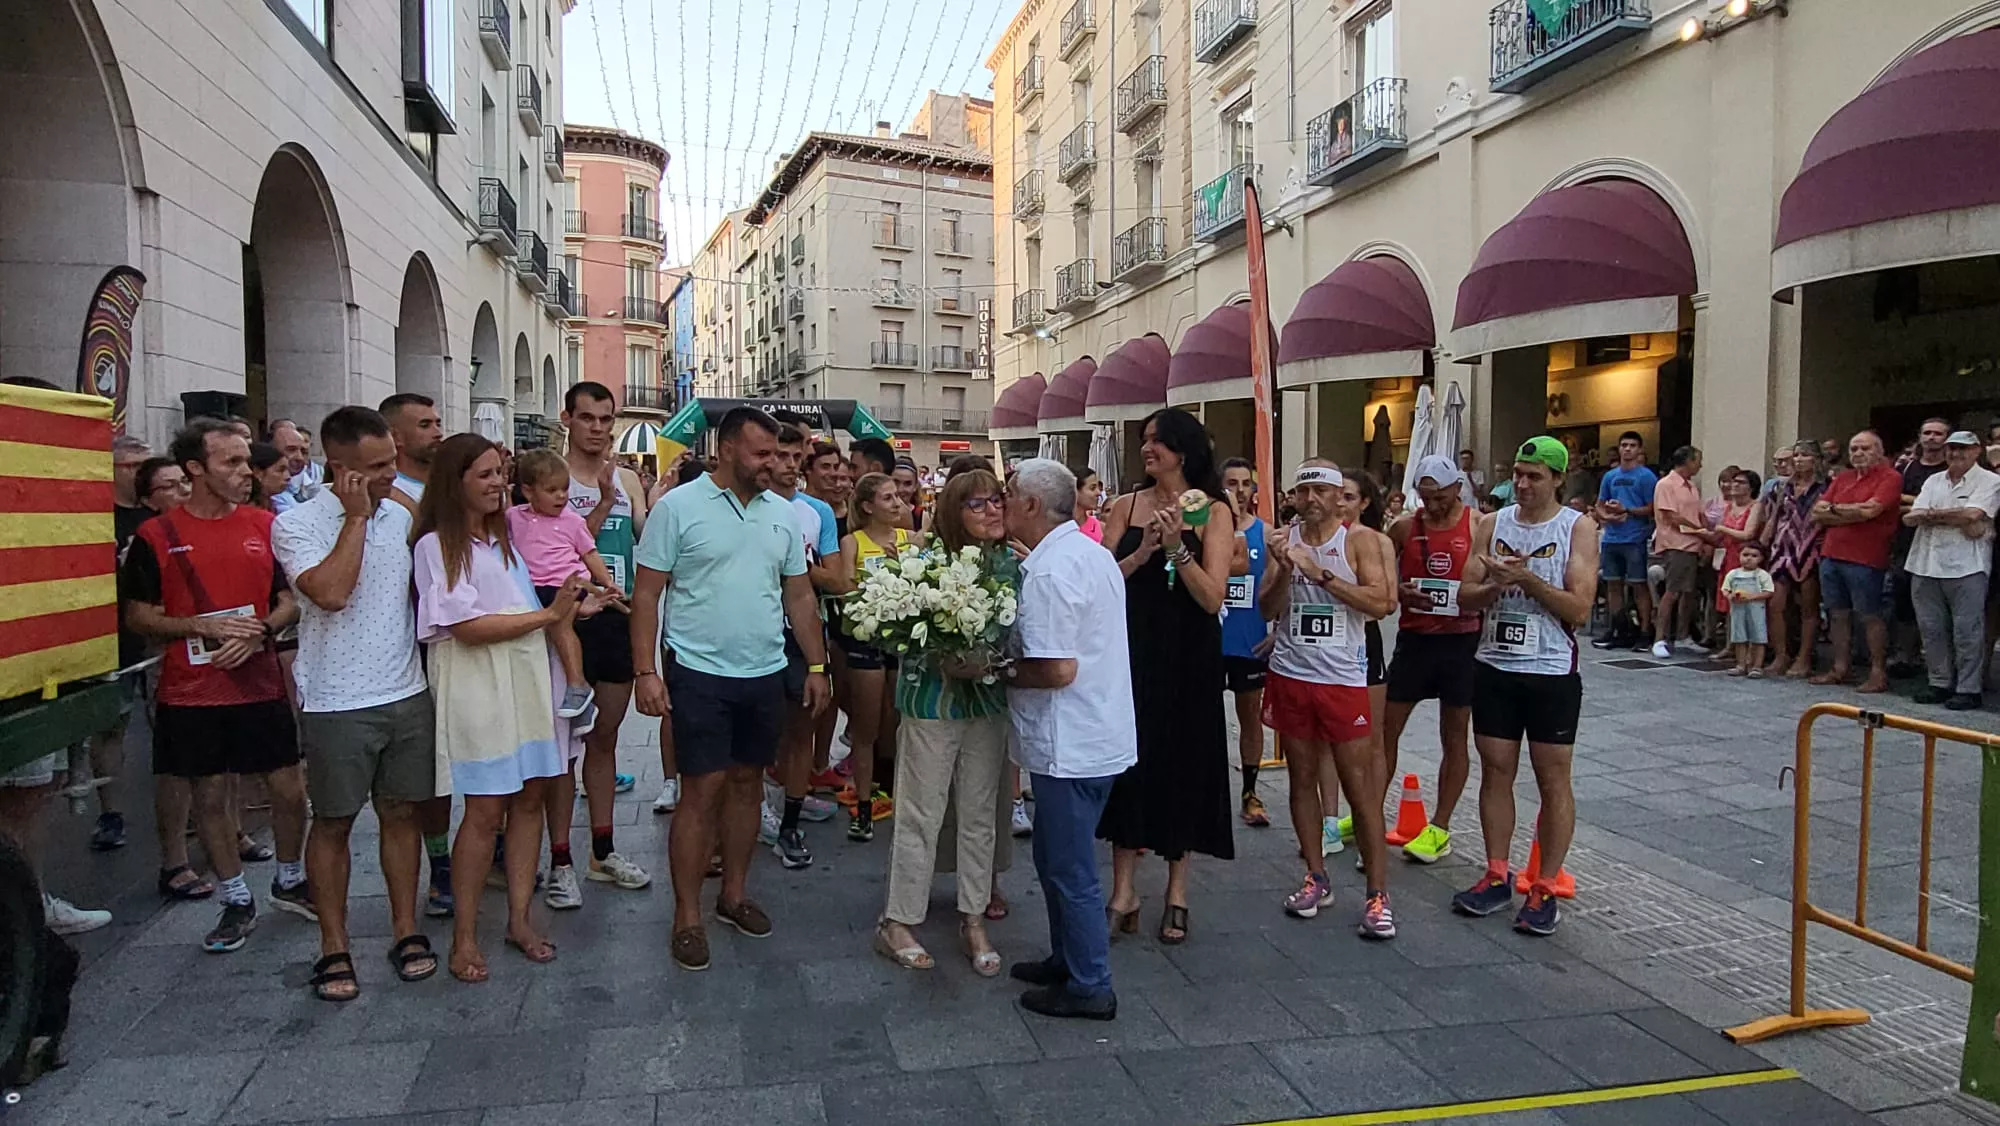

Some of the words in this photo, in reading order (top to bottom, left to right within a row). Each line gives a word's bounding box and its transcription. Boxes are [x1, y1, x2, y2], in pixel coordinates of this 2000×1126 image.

[979, 300, 989, 367] HOSTAL
[1229, 586, 1244, 598] 56
[1430, 591, 1447, 604] 63
[1311, 618, 1330, 633] 61
[1505, 626, 1524, 641] 65
